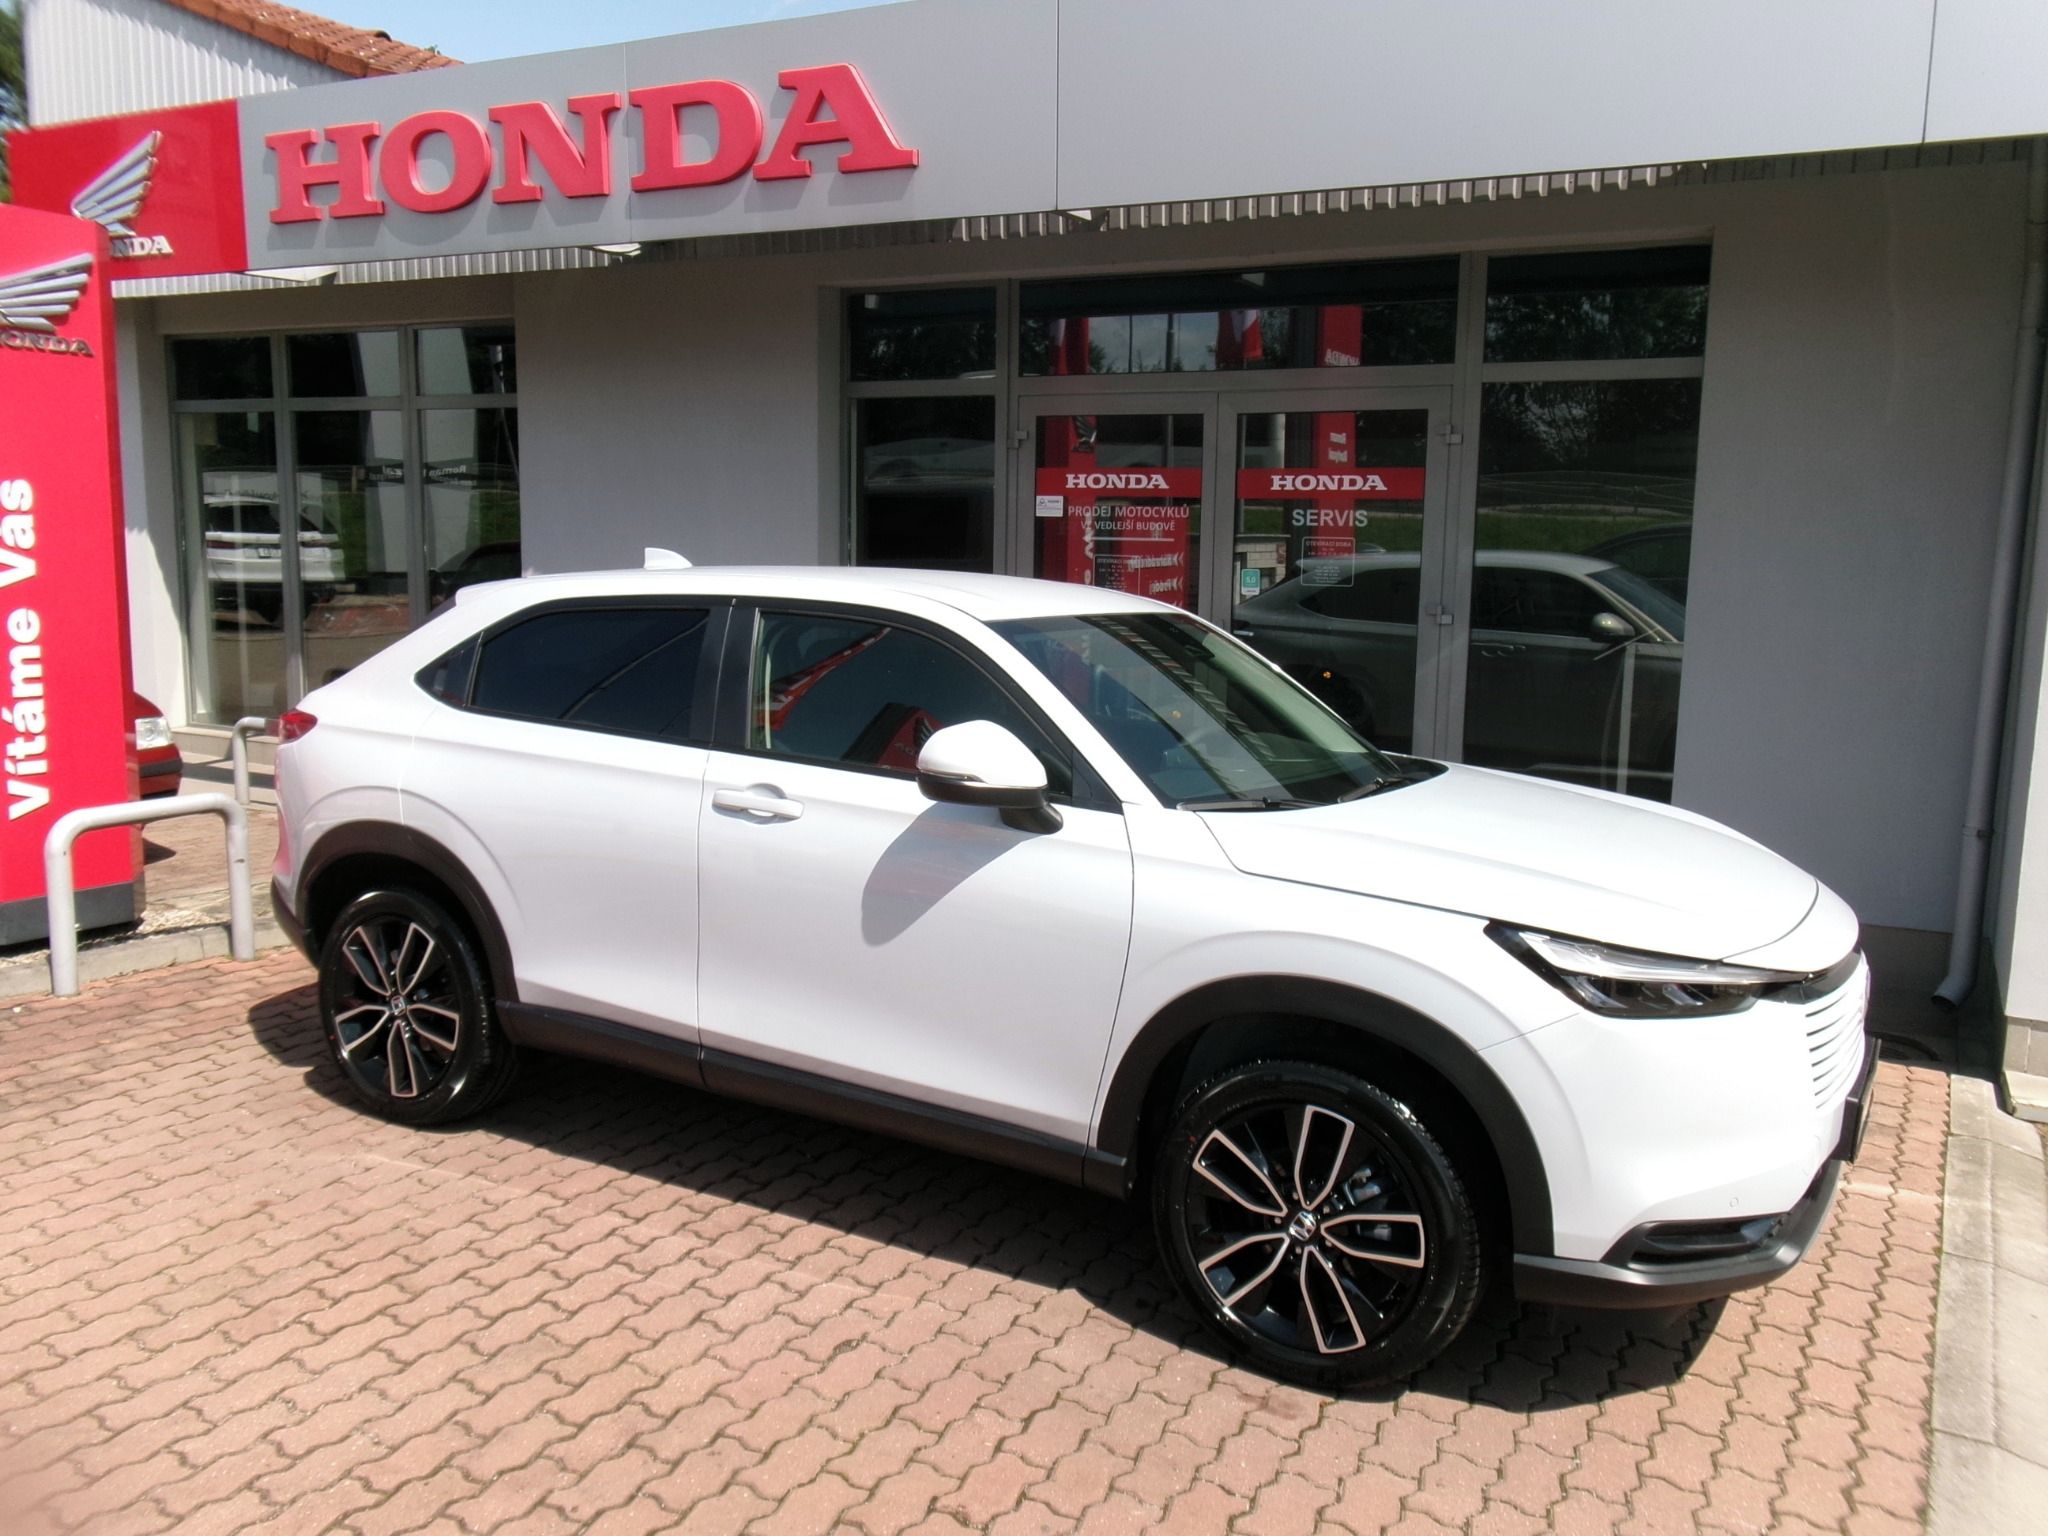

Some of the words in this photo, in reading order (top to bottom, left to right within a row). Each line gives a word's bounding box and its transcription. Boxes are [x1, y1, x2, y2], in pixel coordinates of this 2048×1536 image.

[265, 62, 920, 225] HONDA
[111, 235, 174, 257] NDA
[0, 331, 94, 357] ONDA
[1065, 473, 1169, 490] HONDA
[1270, 474, 1388, 491] HONDA
[1067, 505, 1112, 518] PRODEJ
[1114, 503, 1190, 519] MOTOCYKLŮ
[1292, 509, 1368, 528] SERVIS
[1094, 519, 1134, 531] VEDLEJŠÍ
[1136, 520, 1176, 532] BUDOVĚ
[1, 607, 50, 821] Vítáme
